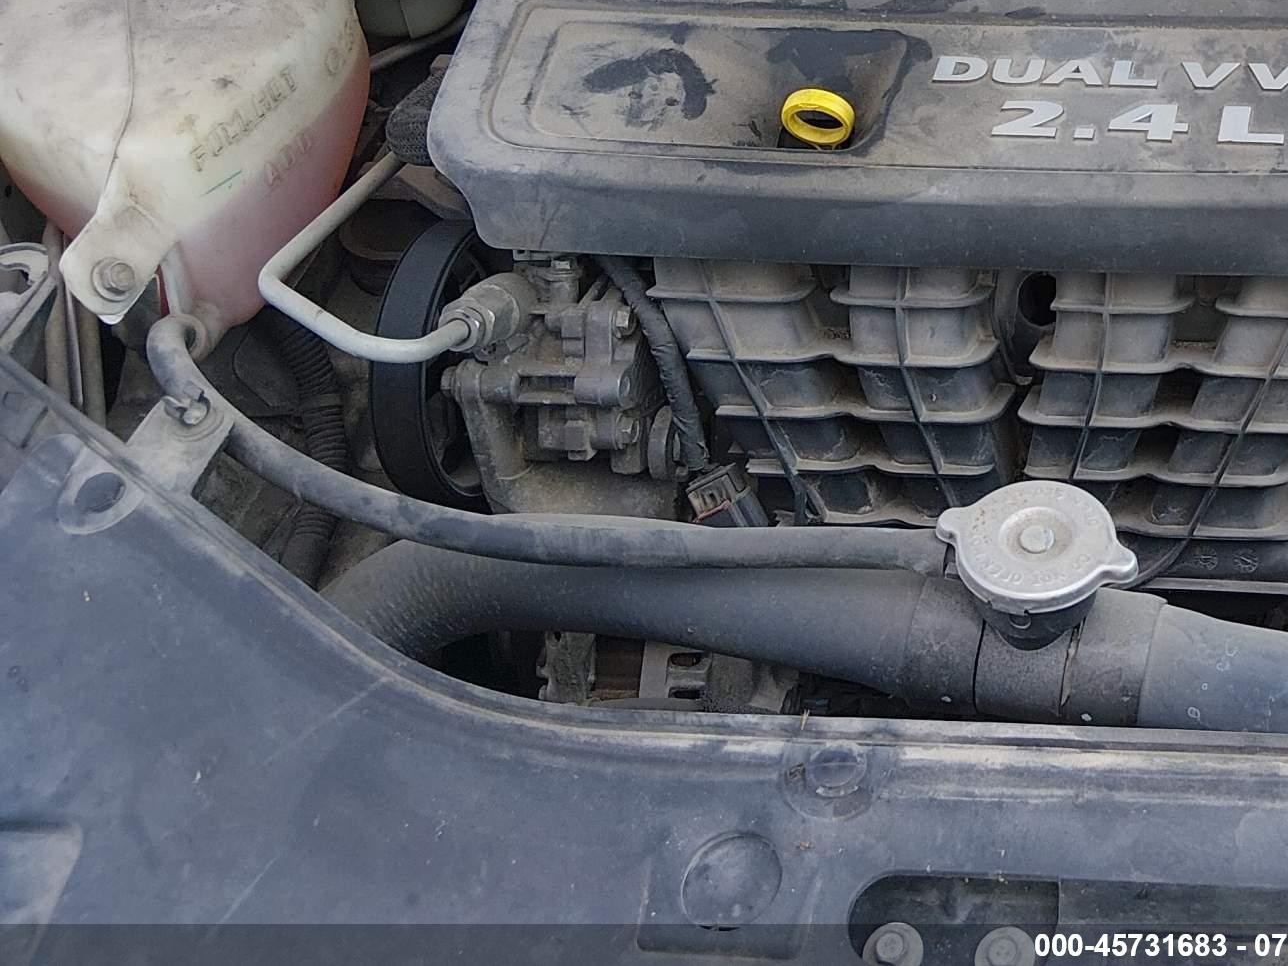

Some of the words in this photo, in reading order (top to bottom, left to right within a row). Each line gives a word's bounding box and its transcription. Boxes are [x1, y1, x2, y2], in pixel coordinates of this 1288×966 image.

[931, 55, 1159, 87] DUAL
[991, 99, 1189, 143] 2.4
[1216, 105, 1285, 145] L
